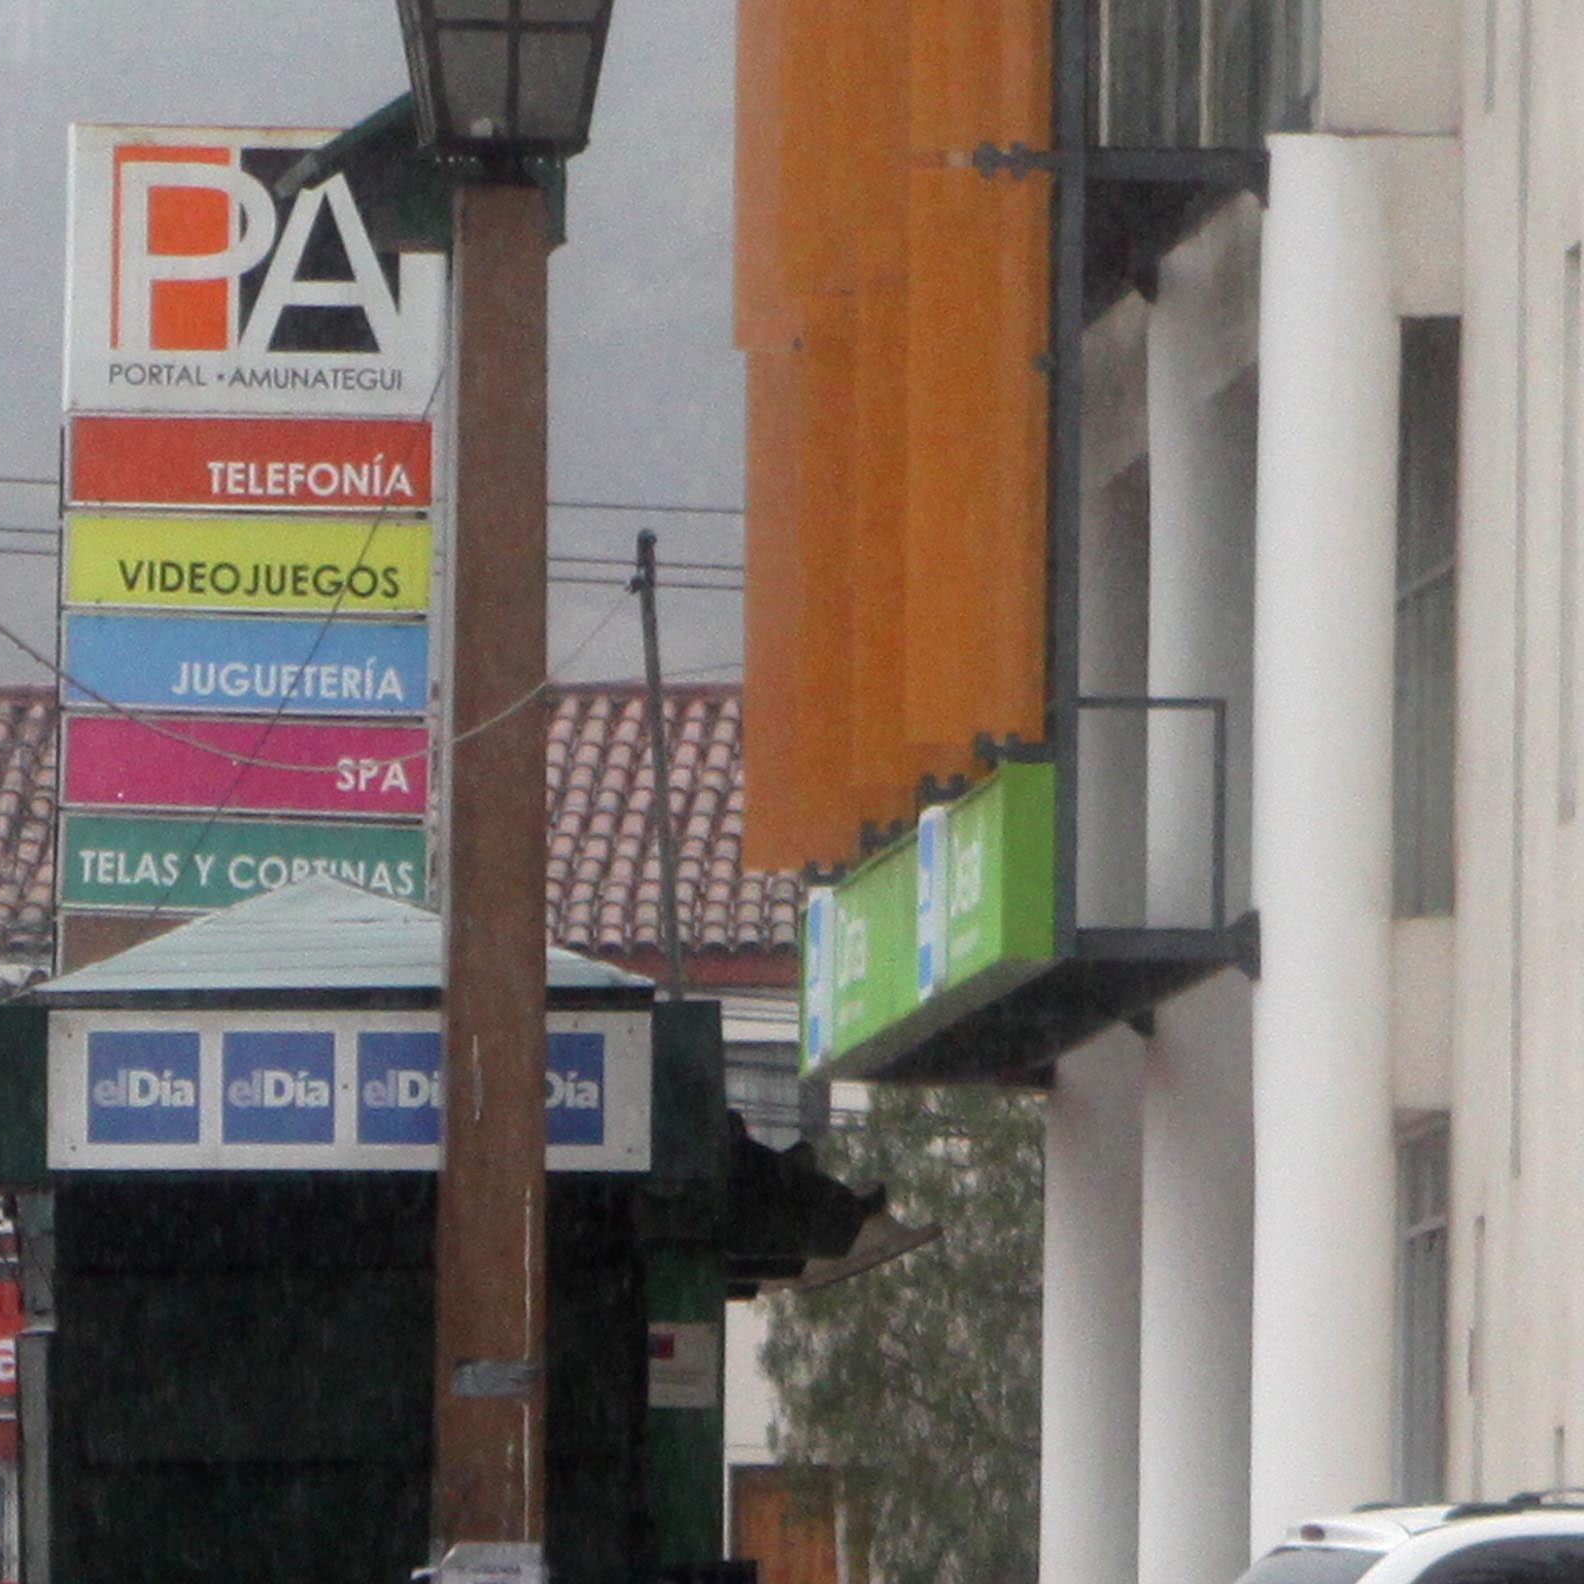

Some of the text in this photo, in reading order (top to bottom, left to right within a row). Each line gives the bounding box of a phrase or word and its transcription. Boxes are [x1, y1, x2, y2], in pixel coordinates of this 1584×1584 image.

[111, 145, 402, 352] PA
[109, 364, 402, 391] PORTAL AMUNATEGUI
[207, 453, 412, 497] TELEFONÍA
[119, 559, 401, 599] VIDEOJUEGOS
[170, 657, 404, 701] JUGUETERÍA
[336, 758, 410, 794] SPA
[78, 848, 179, 887] TELAS
[193, 853, 213, 887] Y
[93, 1068, 599, 1109] elDía elDía elDí Día
